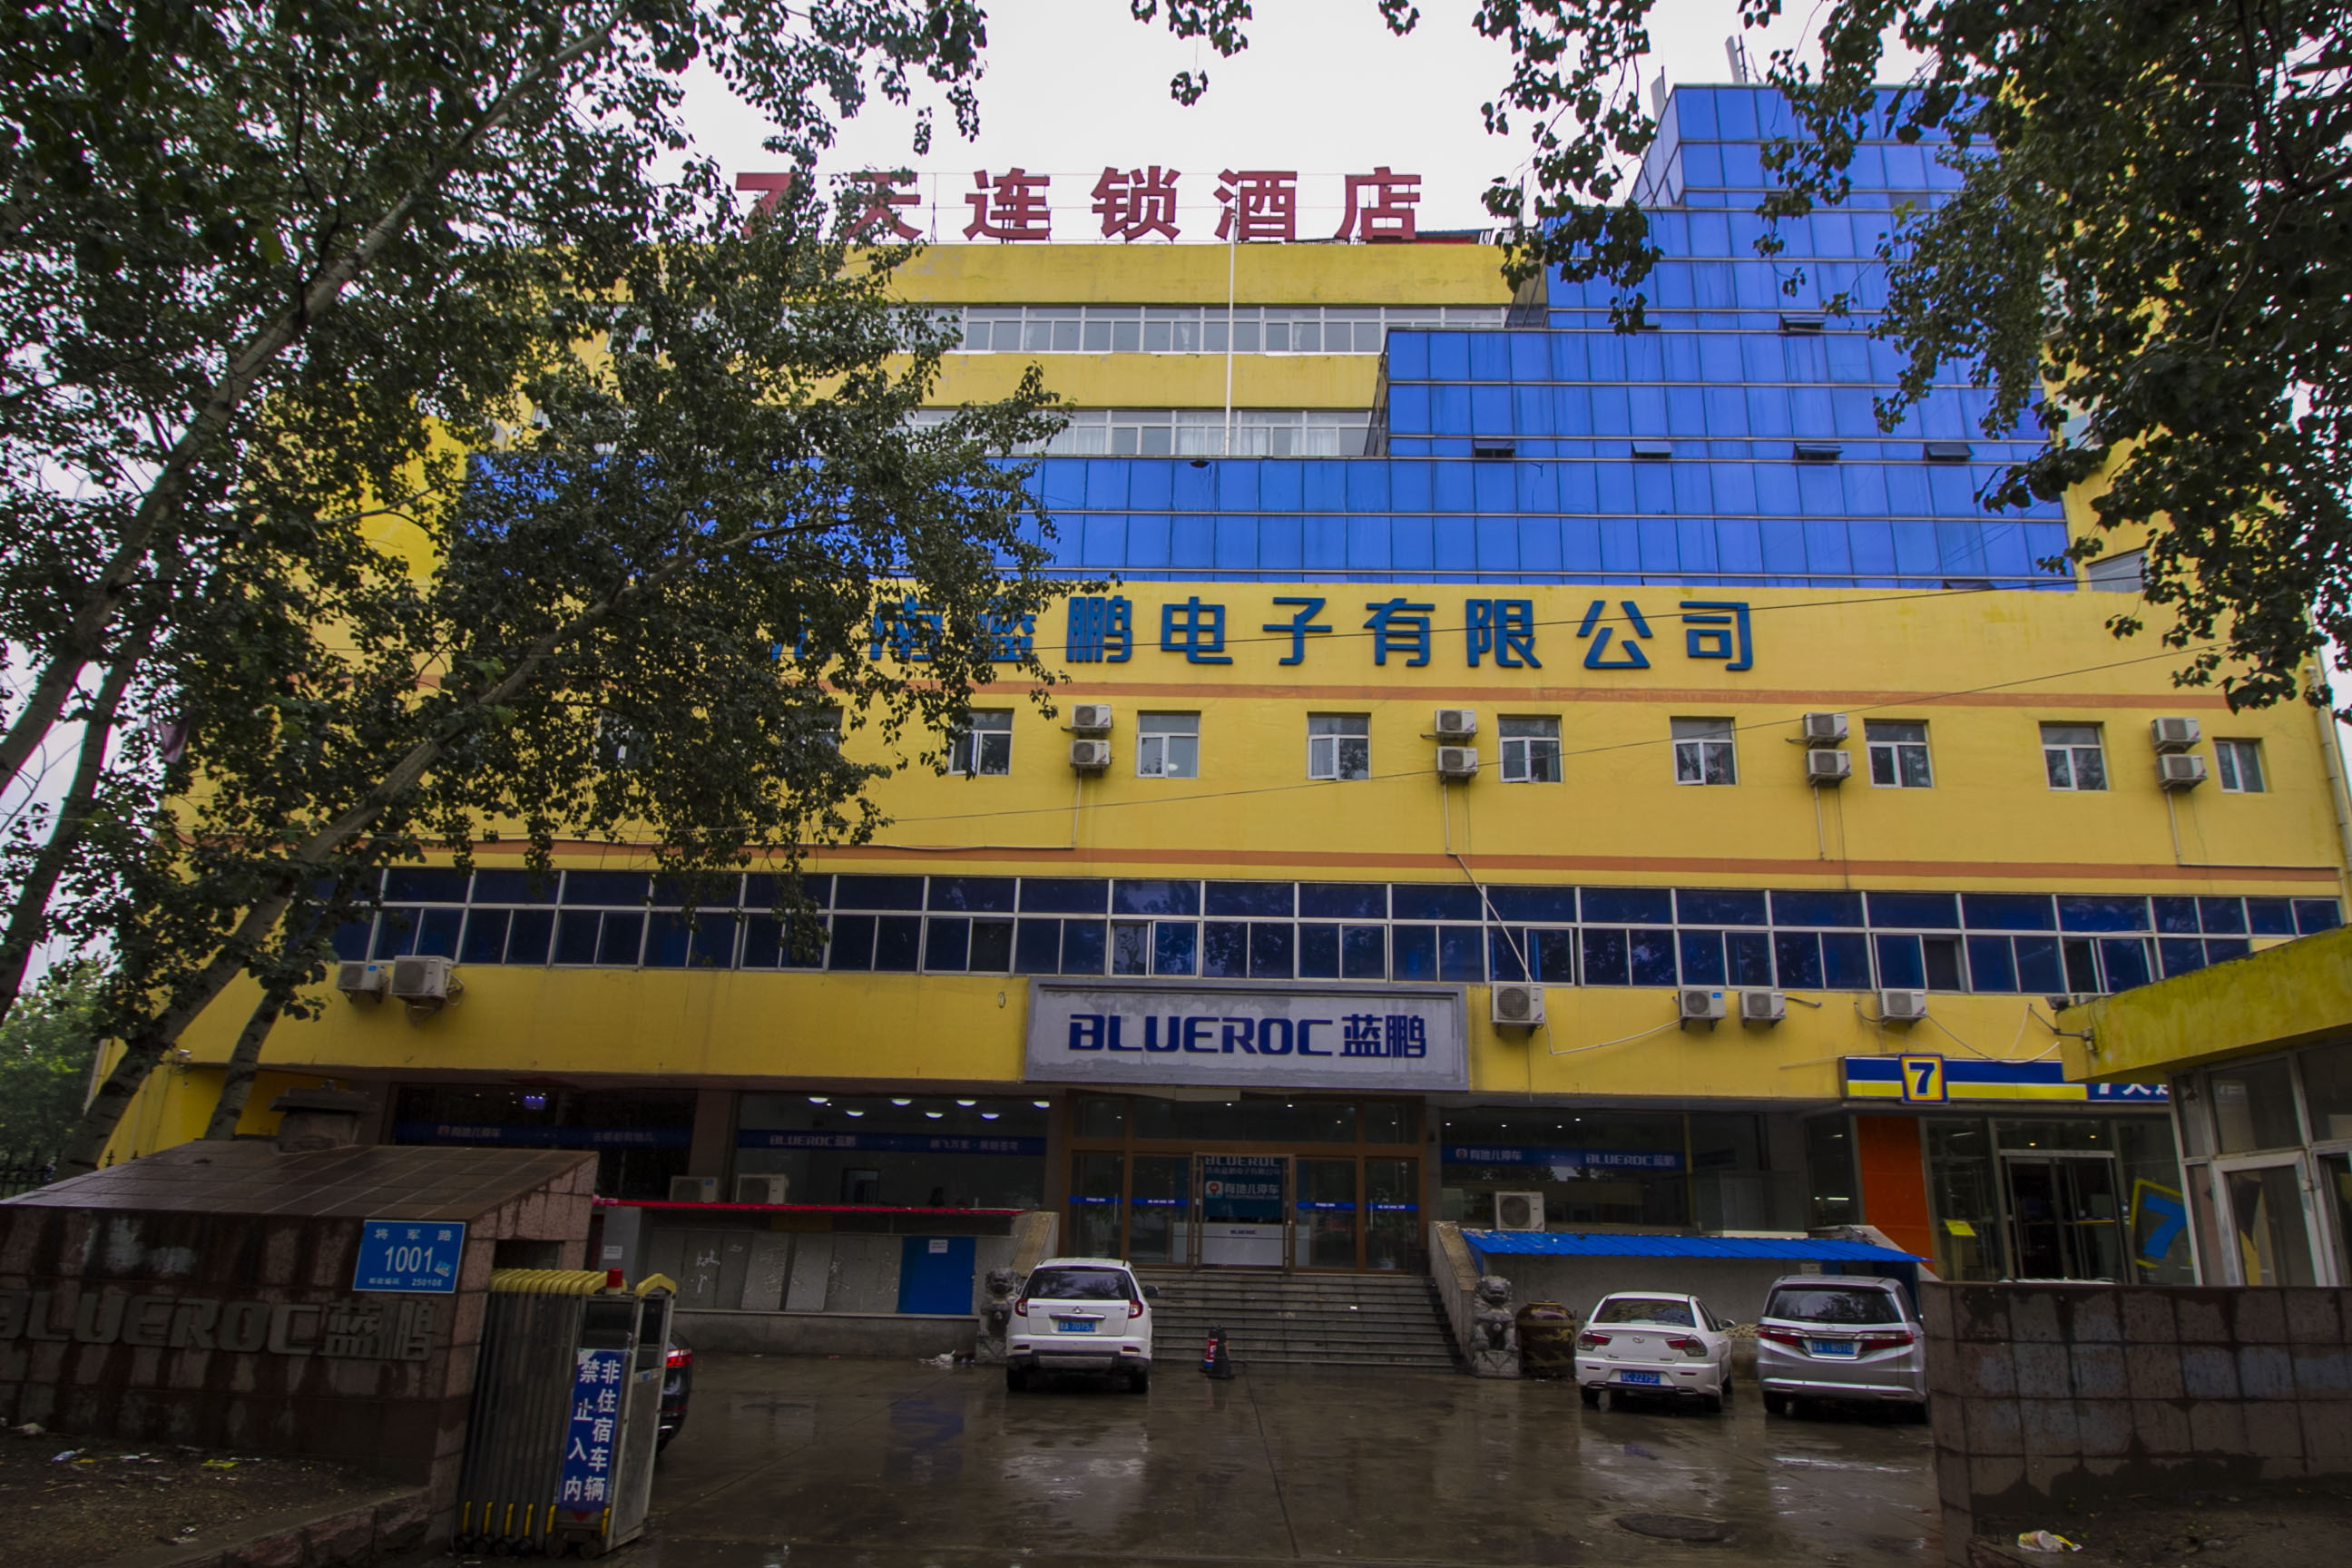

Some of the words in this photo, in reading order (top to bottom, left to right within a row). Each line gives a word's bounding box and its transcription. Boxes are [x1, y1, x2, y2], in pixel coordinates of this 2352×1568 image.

[1069, 1014, 1333, 1057] BLUEROC
[1339, 1014, 1426, 1059] 蓝鹏
[1907, 1060, 1936, 1095] 7
[769, 1134, 834, 1147] BLUEROC
[1585, 1153, 1652, 1166] BLUEROC
[384, 1245, 434, 1273] 1001
[318, 1297, 436, 1362] 蓝鹏
[564, 1358, 600, 1502] 禁止入内
[583, 1359, 621, 1502] 非住宿车辆
